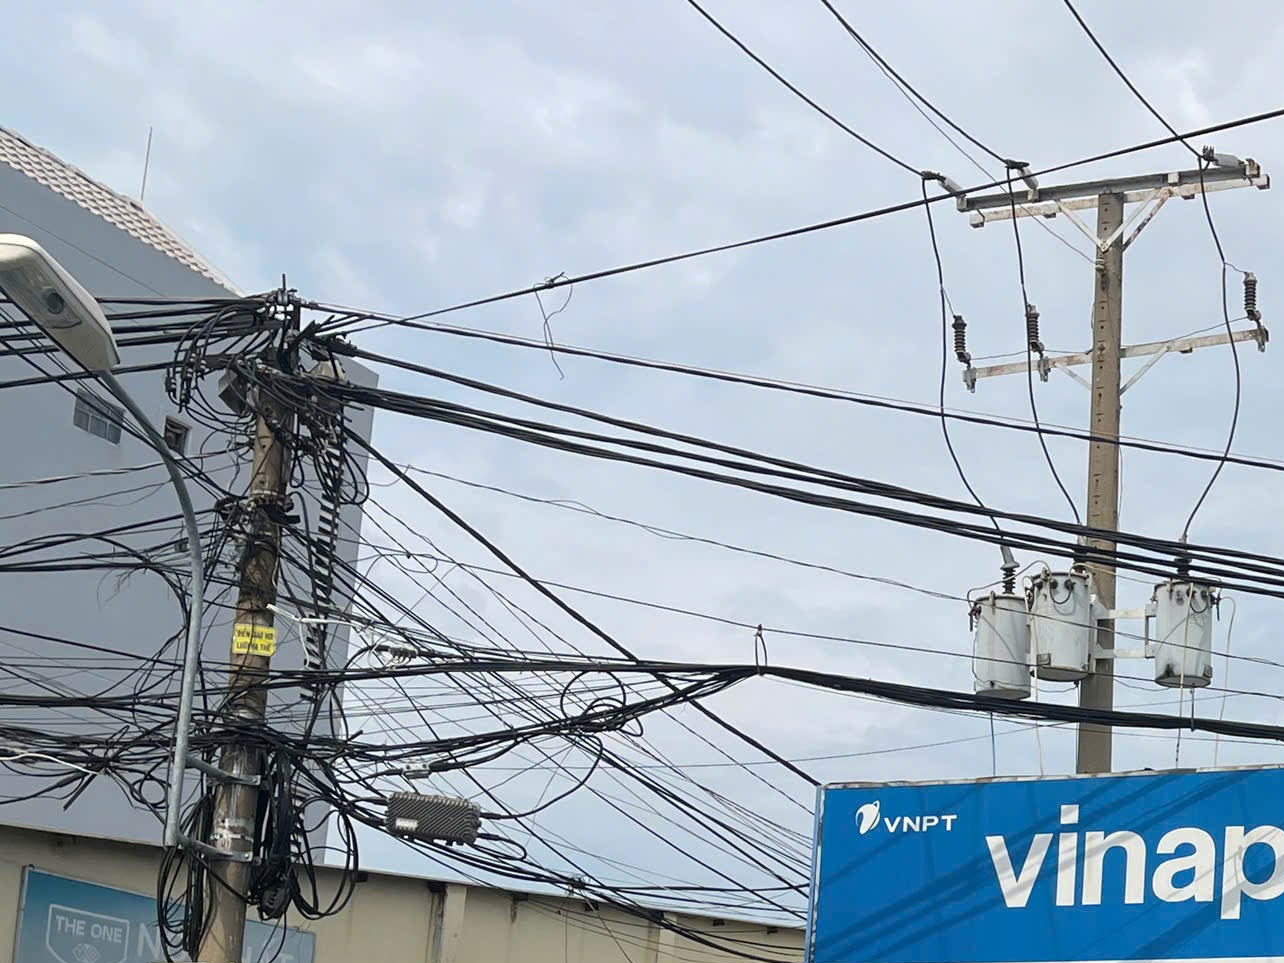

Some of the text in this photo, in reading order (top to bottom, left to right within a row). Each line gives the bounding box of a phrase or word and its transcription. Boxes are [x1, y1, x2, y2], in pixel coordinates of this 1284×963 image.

[884, 814, 957, 832] VNPT
[55, 915, 86, 936] THE
[91, 924, 123, 944] ONE
